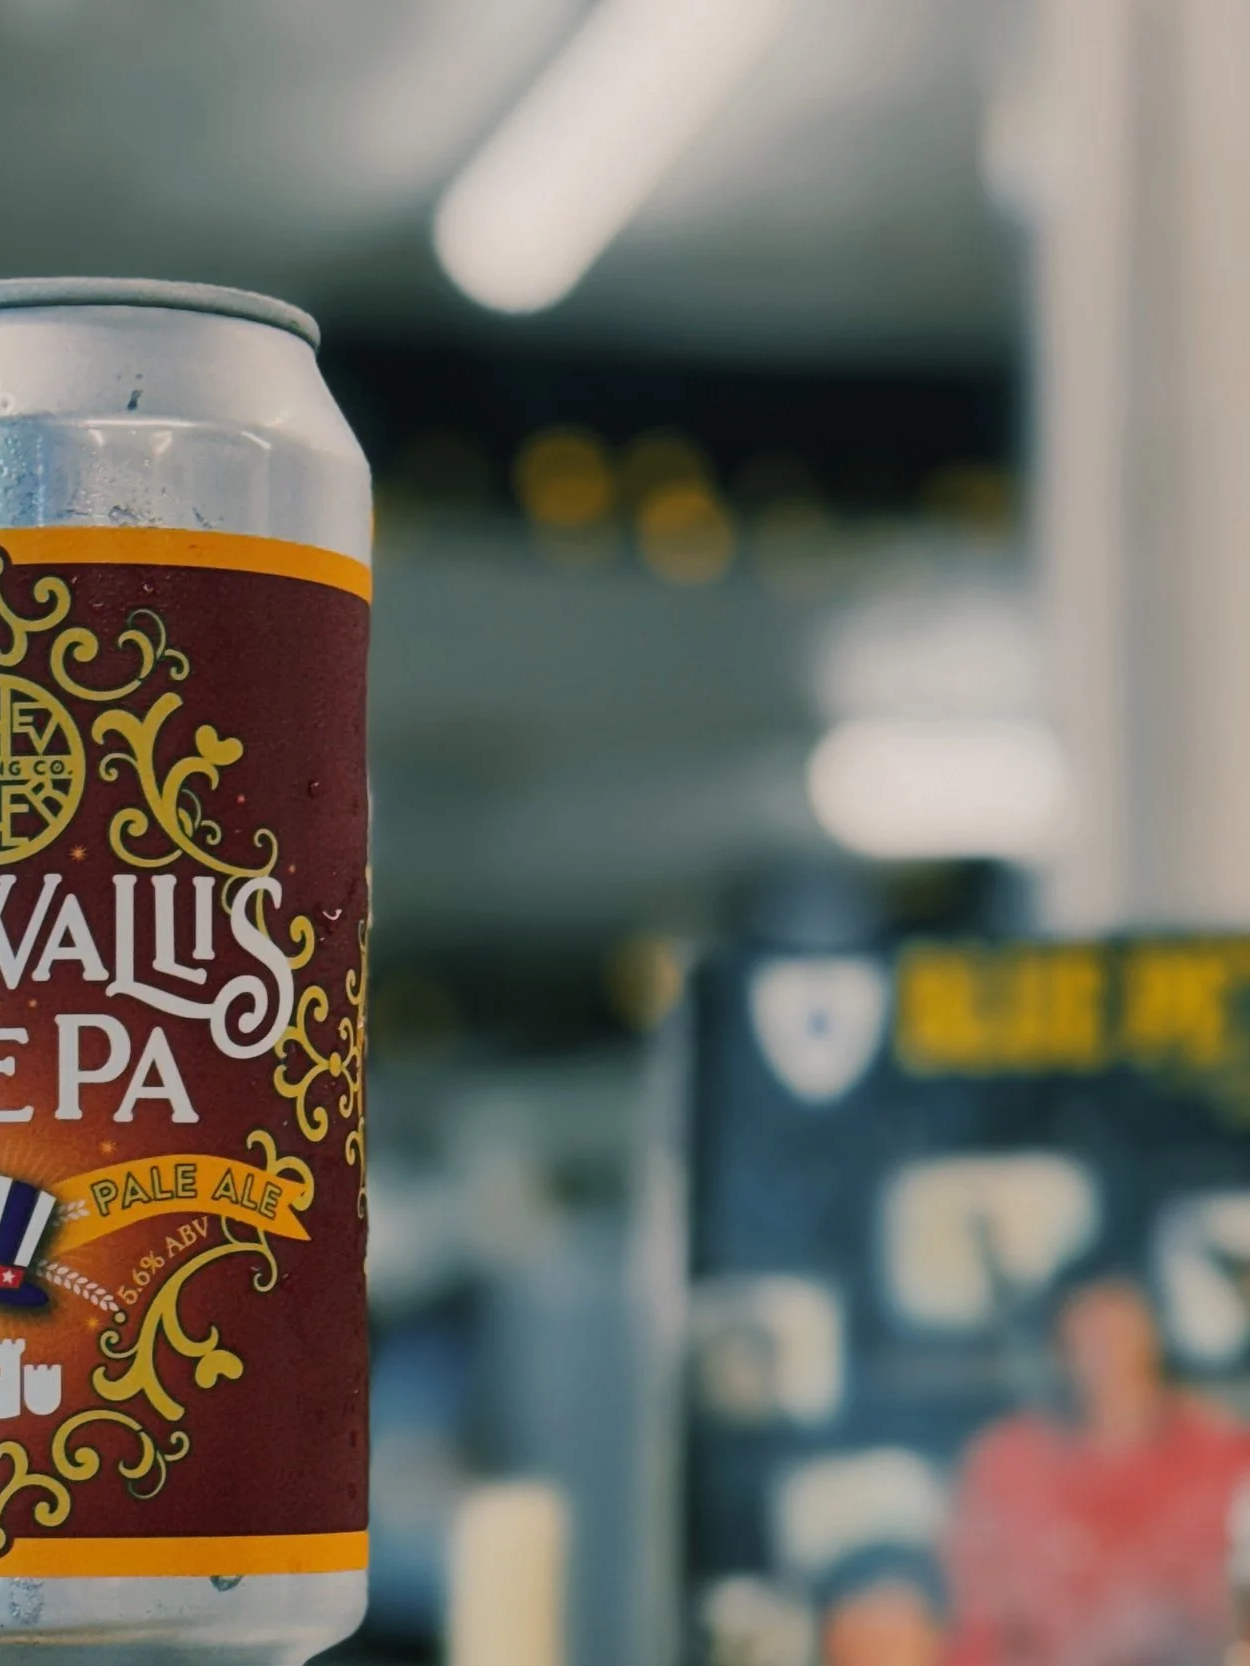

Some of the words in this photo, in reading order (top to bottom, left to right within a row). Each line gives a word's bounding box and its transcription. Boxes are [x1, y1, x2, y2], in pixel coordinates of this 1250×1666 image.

[33, 759, 73, 776] CO.
[54, 1013, 200, 1122] PA
[90, 1163, 197, 1217] PALE
[212, 1167, 283, 1220] ALE
[117, 1250, 166, 1305] 5.6%
[165, 1215, 209, 1258] ABV
